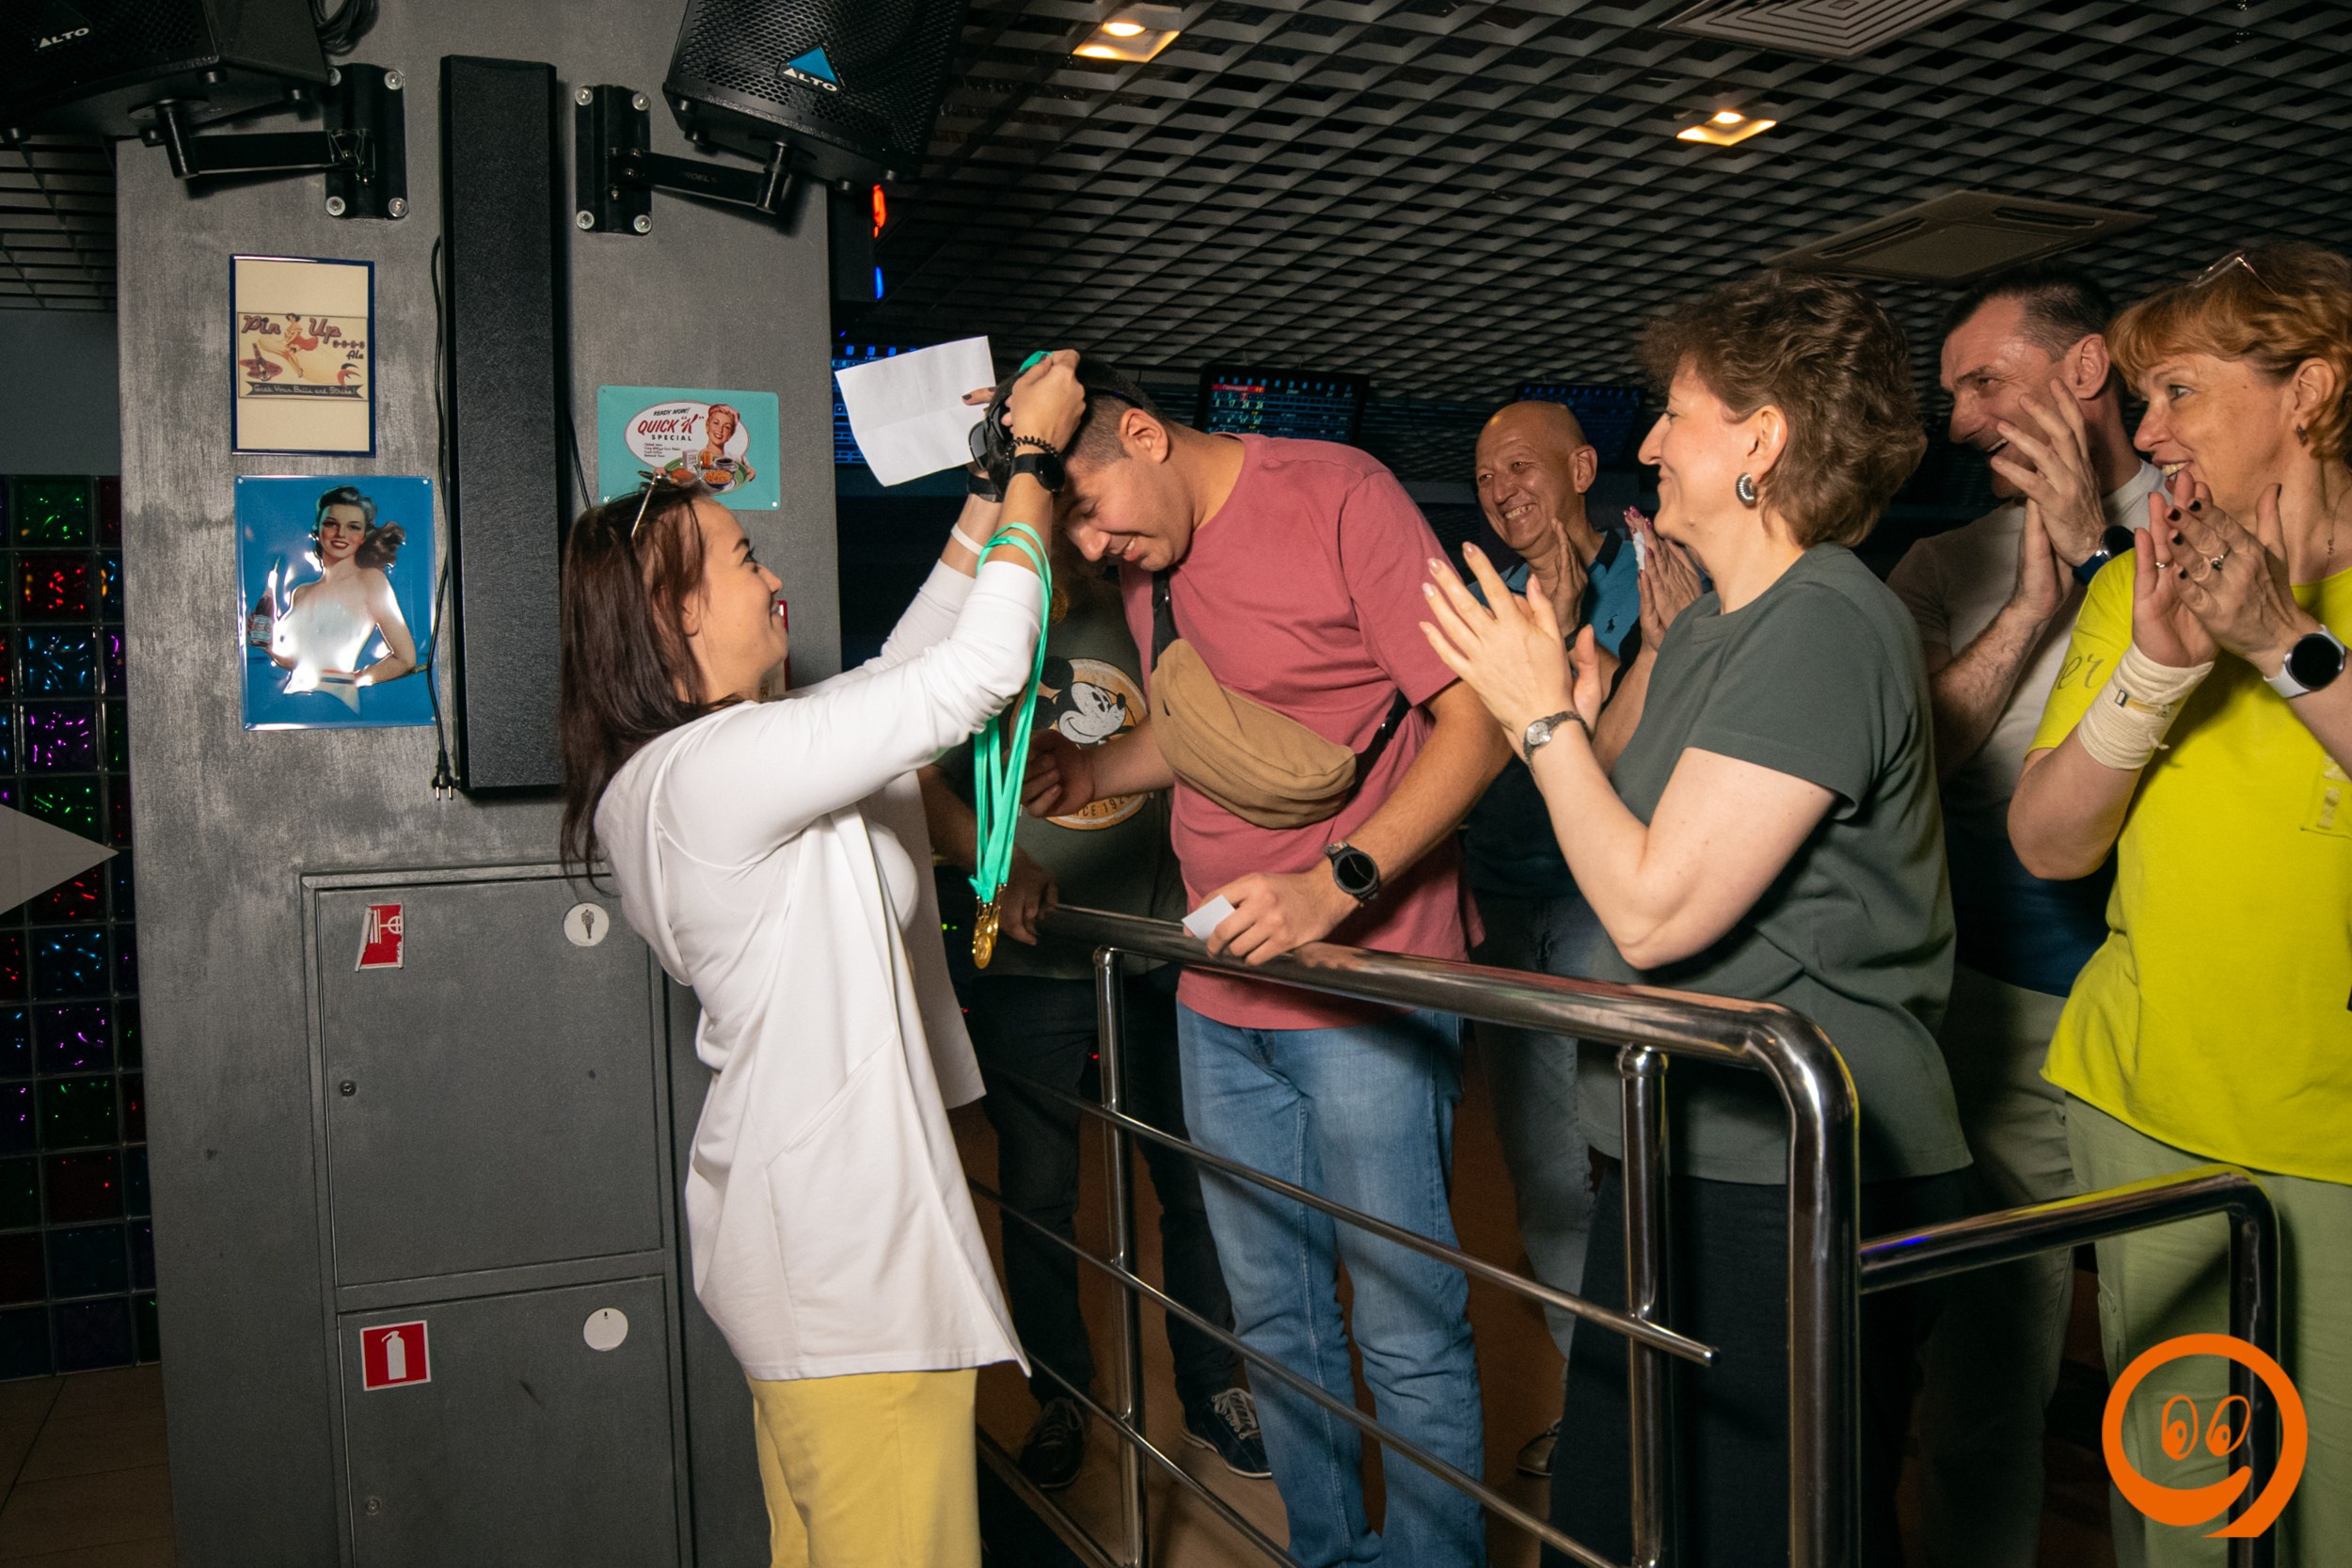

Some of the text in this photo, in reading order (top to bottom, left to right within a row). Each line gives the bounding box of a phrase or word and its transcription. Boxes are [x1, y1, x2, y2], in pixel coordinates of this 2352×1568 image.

[783, 67, 837, 92] ALTO
[241, 315, 342, 344] Pin Up
[345, 350, 364, 360] Ale
[638, 420, 679, 436] QUICK
